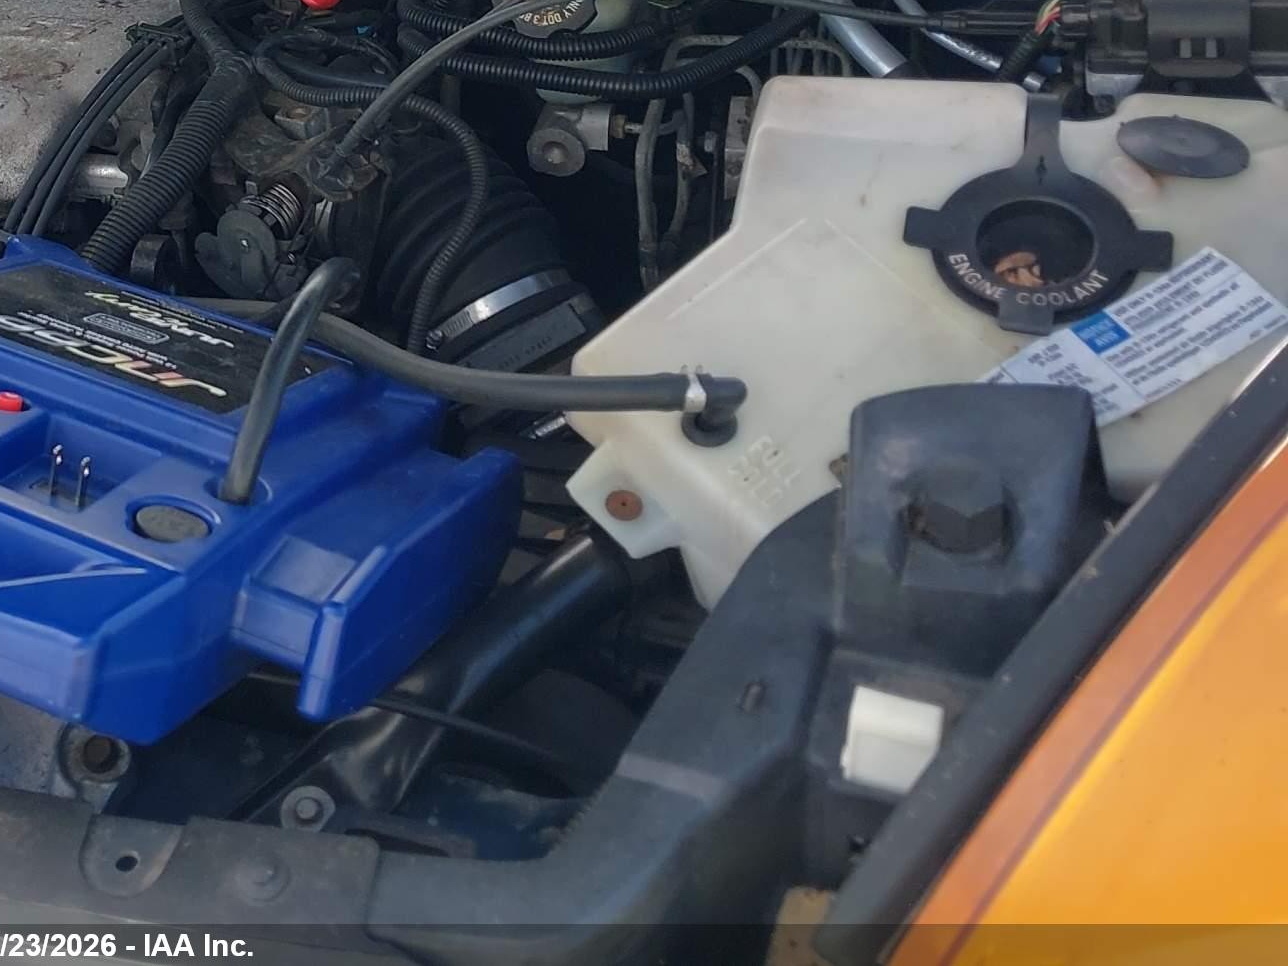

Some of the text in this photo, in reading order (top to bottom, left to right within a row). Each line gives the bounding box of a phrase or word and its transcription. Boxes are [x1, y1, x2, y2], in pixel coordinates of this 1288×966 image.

[948, 253, 1008, 299] ENGINE
[1015, 269, 1110, 306] COOLANT
[745, 434, 803, 488] FULL
